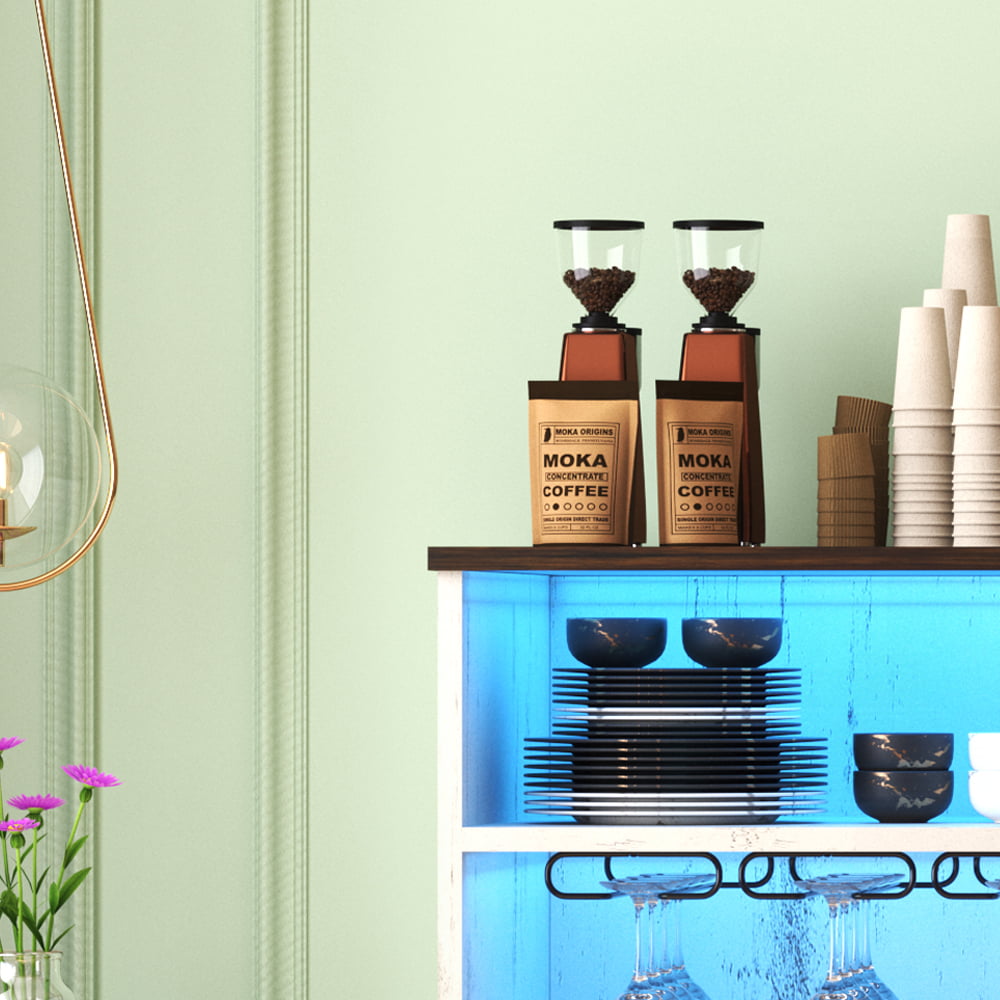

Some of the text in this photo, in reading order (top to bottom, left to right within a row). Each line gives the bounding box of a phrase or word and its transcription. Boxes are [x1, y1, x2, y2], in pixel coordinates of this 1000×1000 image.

[555, 428, 613, 436] MOKA ORIGINS
[688, 428, 707, 436] MOKA
[543, 454, 608, 468] MOKA
[678, 454, 732, 468] MOKA
[546, 472, 604, 481] CONCENTRATE
[543, 485, 608, 497] COFFEE
[677, 485, 735, 498] COFFEE
